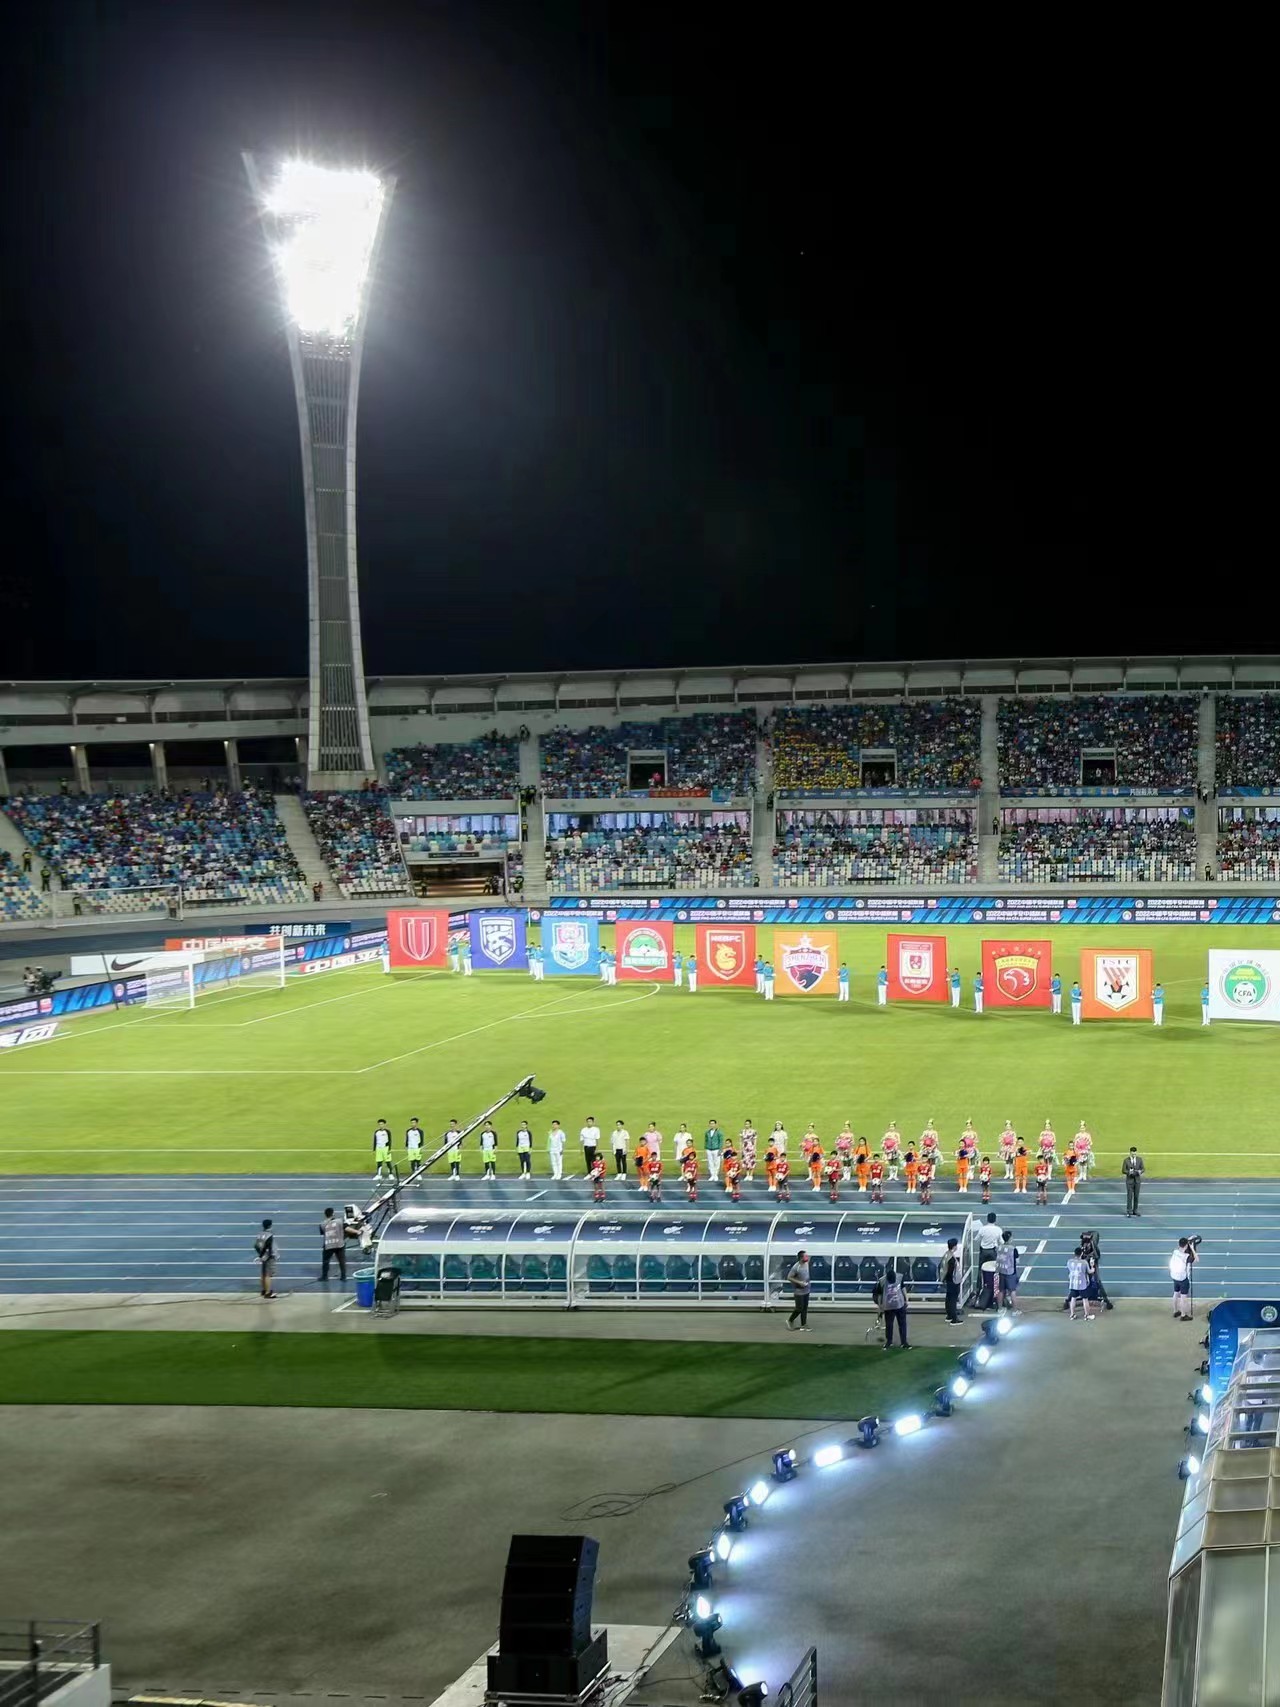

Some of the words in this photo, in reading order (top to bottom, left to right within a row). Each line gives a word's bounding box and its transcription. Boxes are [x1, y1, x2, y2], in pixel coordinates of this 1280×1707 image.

[269, 924, 327, 936] 共创新未来
[1237, 990, 1253, 998] CFA
